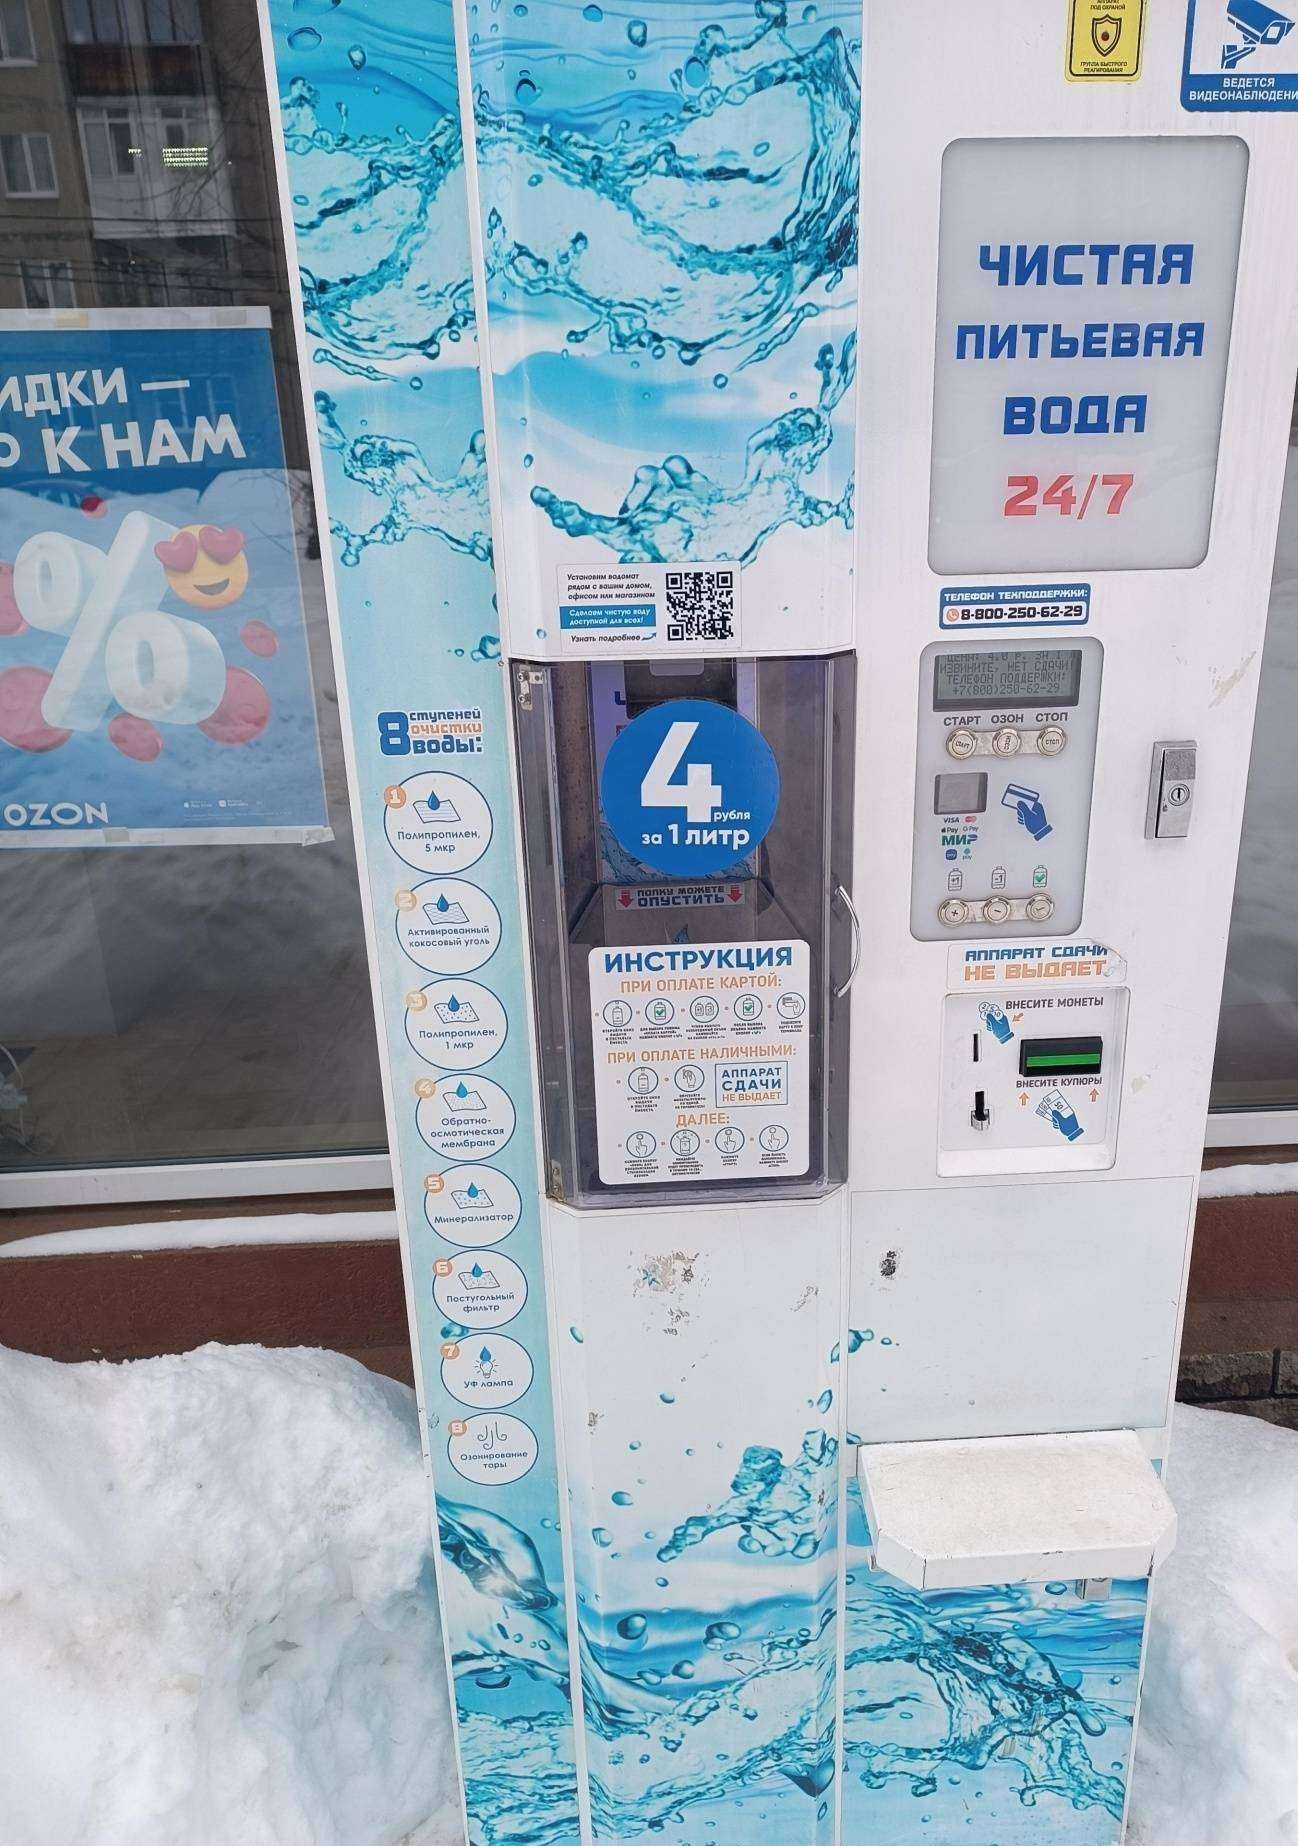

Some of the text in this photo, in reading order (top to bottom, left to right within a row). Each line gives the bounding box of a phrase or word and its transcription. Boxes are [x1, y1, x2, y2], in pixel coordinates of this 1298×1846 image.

[1223, 78, 1275, 89] ВЕДЕТСЯ
[979, 244, 1194, 286] ЧИСТАЯ
[956, 322, 1205, 359] ПИТЬЕВАЯ
[1003, 395, 1148, 435] ВОДА
[41, 425, 92, 474] К
[101, 414, 247, 469] НАМ
[1004, 474, 1134, 520] 24/7
[567, 573, 606, 581] Установим
[568, 584, 591, 592] рядом
[625, 582, 652, 590] домом,
[568, 593, 598, 601] офисом
[944, 588, 1089, 602] ТЕЛЕФОН ТЕХПОДДЕРЖКИ:
[569, 608, 651, 617] Сделаем чистую воду
[960, 605, 1083, 621] 8-800-250-62-29
[569, 618, 608, 627] доступной
[624, 616, 645, 624] всех!
[571, 633, 641, 643] Узнать подробнее
[947, 673, 995, 685] ТЕЛЕФОН
[410, 708, 481, 722] ступеней
[943, 715, 981, 727] СТАРТ
[991, 713, 1024, 724] ОЗОН
[1035, 712, 1068, 723] СТОП
[378, 712, 411, 756] 8
[411, 722, 482, 734] очистки
[412, 735, 483, 754] воды:
[641, 721, 750, 822] 4 рубля
[3, 801, 109, 827] OZON
[397, 831, 481, 841] Полипропилен,
[642, 824, 750, 850] за 1 литр
[942, 834, 978, 846] МИР
[425, 844, 456, 854] 5 мкр
[637, 886, 725, 897] ПОЛКУ МОЖЕТЕ
[637, 894, 725, 907] ОПУСТИТЬ
[408, 927, 490, 937] Активированный
[409, 938, 490, 948] кокосовый уголь
[965, 945, 1108, 962] АППАРАТ СДАЧИ
[605, 947, 792, 973] ИНСТРУКЦИЯ
[964, 960, 1107, 981] НЕ ВЫДАЕТ
[620, 972, 782, 993] ПРИ ОПЛАТЕ КАРТОЙ:
[1005, 999, 1054, 1010] ВНЕСИТЕ
[1057, 997, 1104, 1007] МОНЕТЫ
[446, 1041, 474, 1050] 1 мкр
[607, 1044, 797, 1064] ПРИ ОПЛАТЕ НАЛИЧНЫМИ:
[722, 1067, 782, 1078] АППАРАТ
[721, 1079, 782, 1092] СДАЧИ
[1016, 1076, 1103, 1088] ВНЕСИТЕ КУПЮРЫ
[722, 1091, 782, 1102] НЕ ВЫДАЕТ
[441, 1117, 492, 1127] Обратно-
[676, 1112, 730, 1128] ДАЛЕЕ:
[430, 1128, 504, 1138] осмотическая
[441, 1139, 495, 1149] мембрана
[434, 1214, 514, 1224] Минерализатор
[446, 1291, 515, 1303] Постугольный
[463, 1304, 500, 1313] фильтр
[464, 1379, 513, 1389] УФ лампа
[460, 1451, 528, 1461] Озонирование
[483, 1461, 507, 1470] тары
